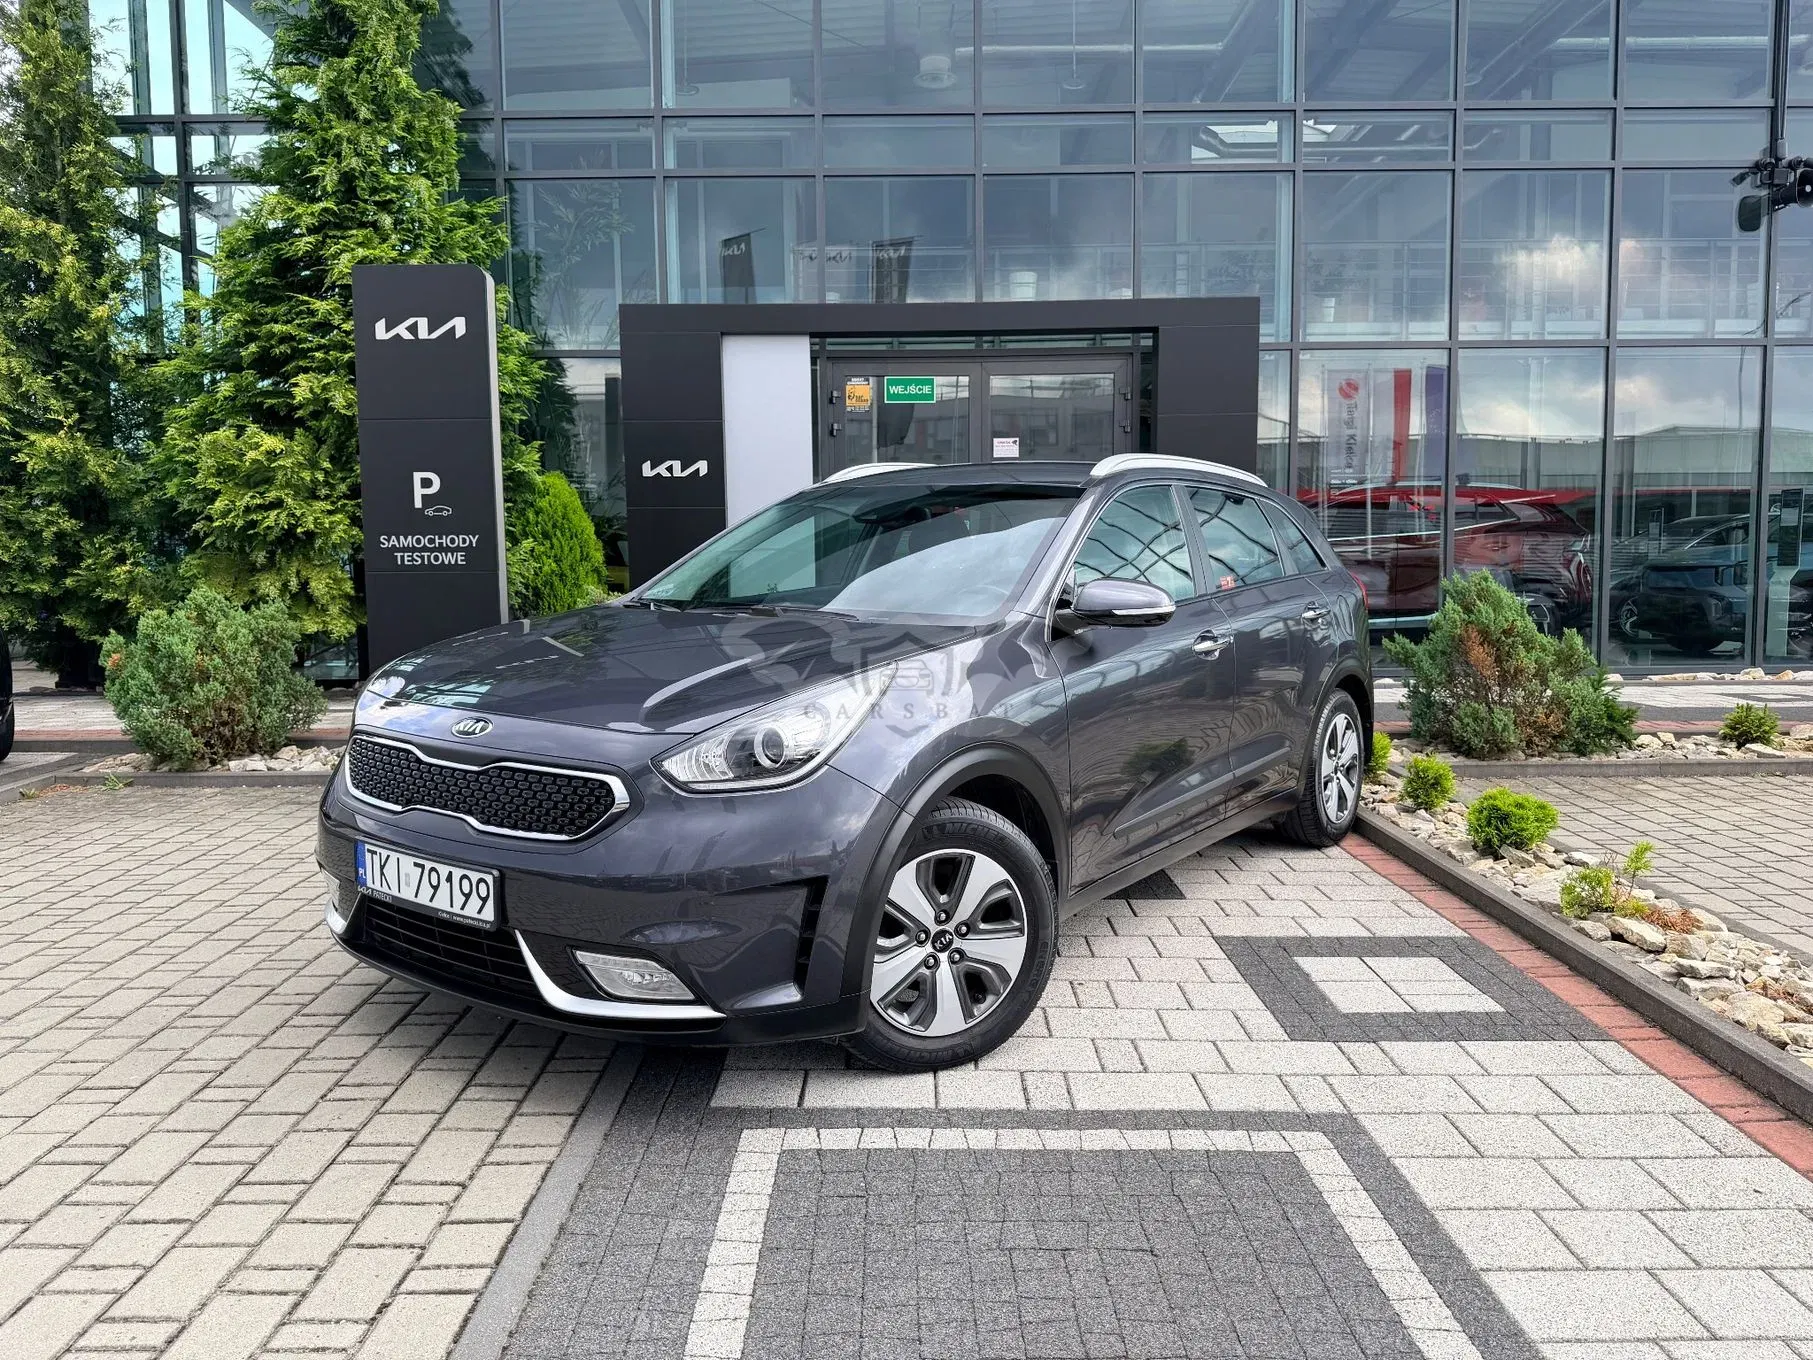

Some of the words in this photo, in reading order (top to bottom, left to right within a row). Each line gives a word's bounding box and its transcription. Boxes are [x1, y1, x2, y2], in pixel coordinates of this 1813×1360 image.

[374, 316, 467, 340] KIA
[888, 383, 933, 395] WEJŚCIE
[1344, 400, 1358, 430] Targi
[641, 459, 709, 478] KIA
[412, 471, 442, 509] P
[379, 533, 480, 549] SAMOCHODY
[394, 551, 467, 566] TESTOWE
[455, 718, 484, 734] KIA
[358, 867, 367, 879] PL
[366, 848, 402, 894] TKI
[412, 861, 491, 915] 79199
[933, 933, 953, 951] KIA
